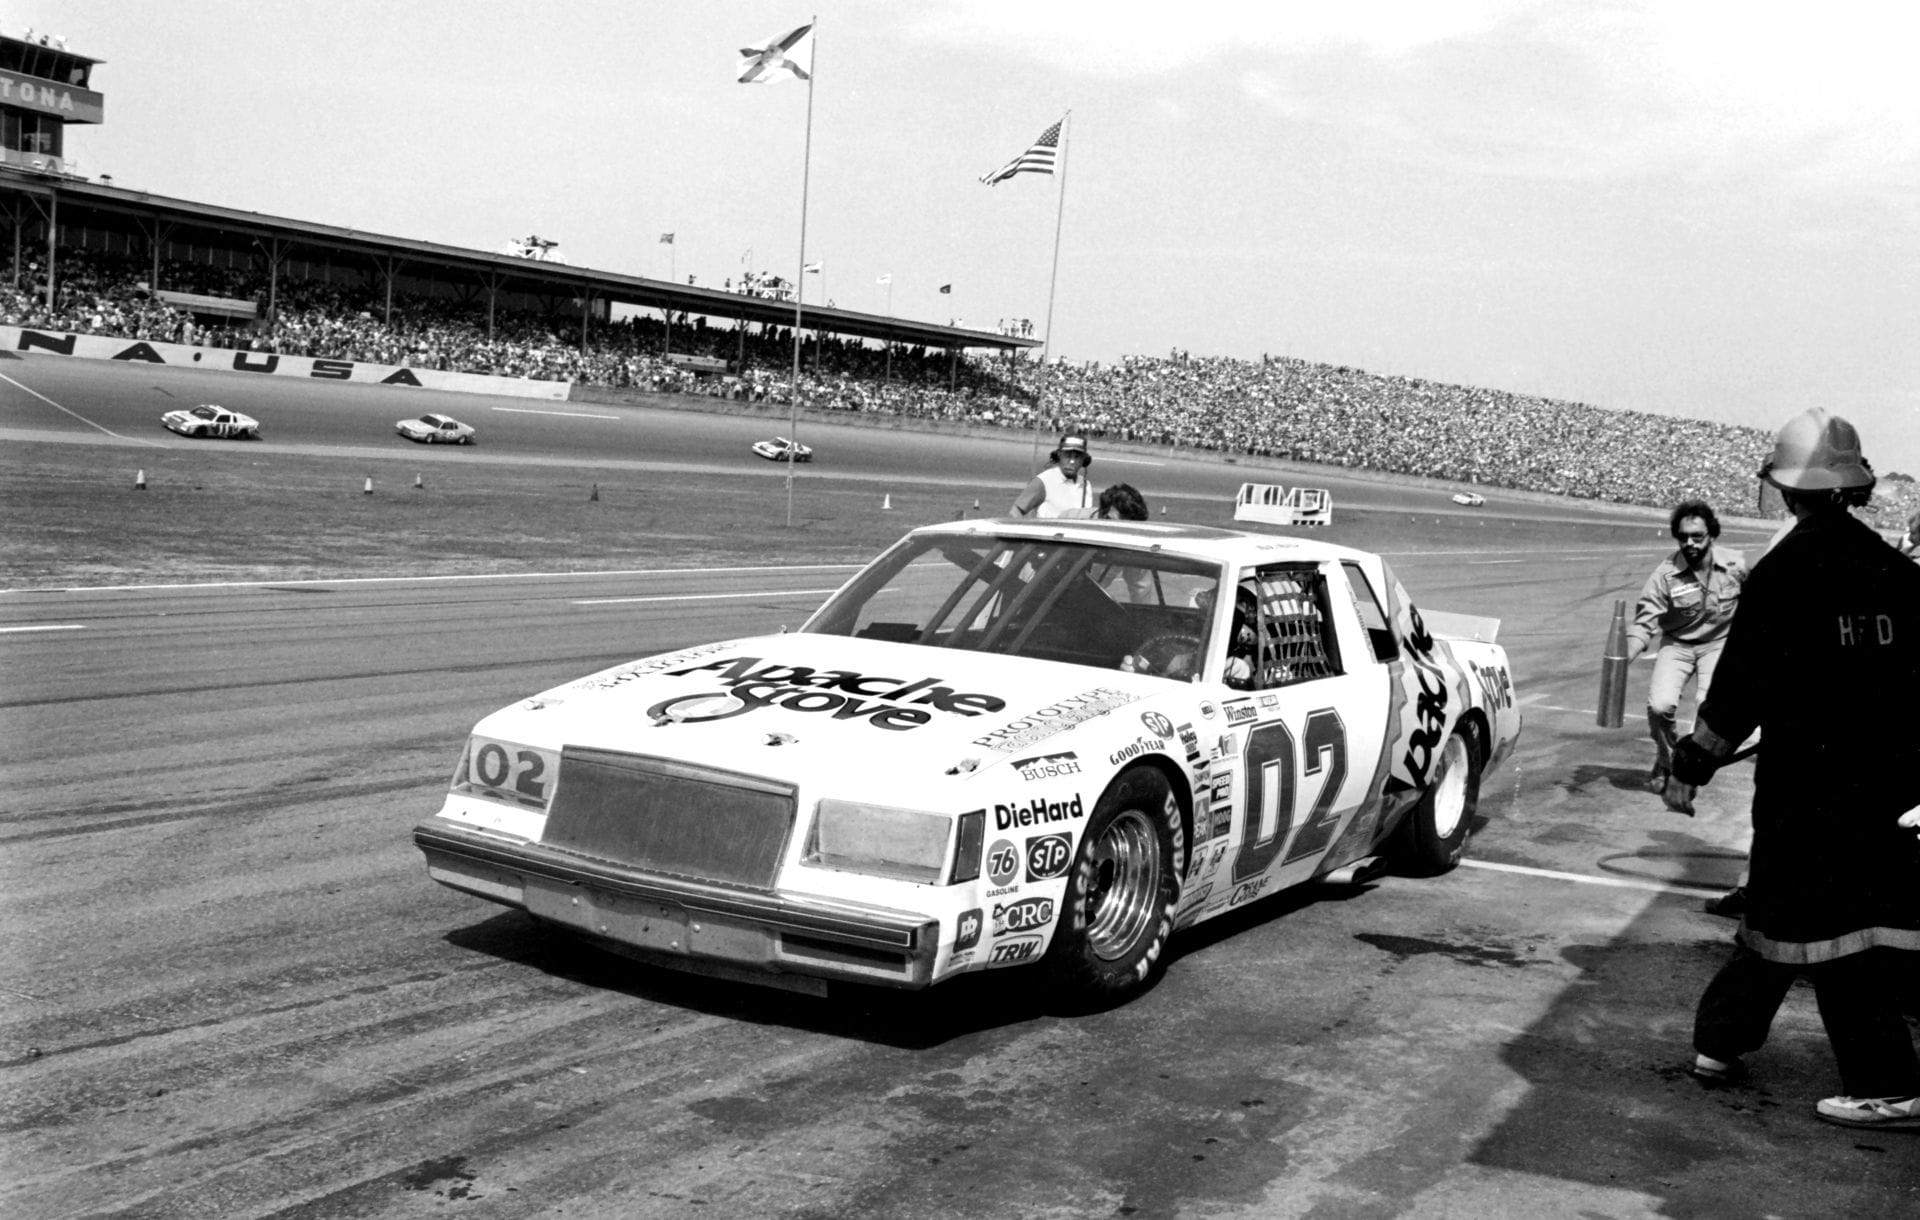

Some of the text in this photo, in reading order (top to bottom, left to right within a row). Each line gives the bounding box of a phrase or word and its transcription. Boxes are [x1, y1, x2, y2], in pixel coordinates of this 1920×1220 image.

[663, 657, 1006, 717] Apache
[647, 683, 932, 731] Stove
[971, 687, 1114, 748] PROTOTYPE
[1223, 705, 1258, 722] Winston
[1143, 711, 1172, 739] STP
[476, 743, 545, 798] 02
[1020, 762, 1082, 781] BUSCH
[994, 792, 1083, 831] DieHard
[1232, 707, 1348, 886] 02
[989, 846, 1016, 877] 76
[1033, 840, 1066, 870] STP
[986, 885, 1019, 898] GASOLINE
[1006, 900, 1053, 930] CRC
[992, 940, 1040, 963] TRW
